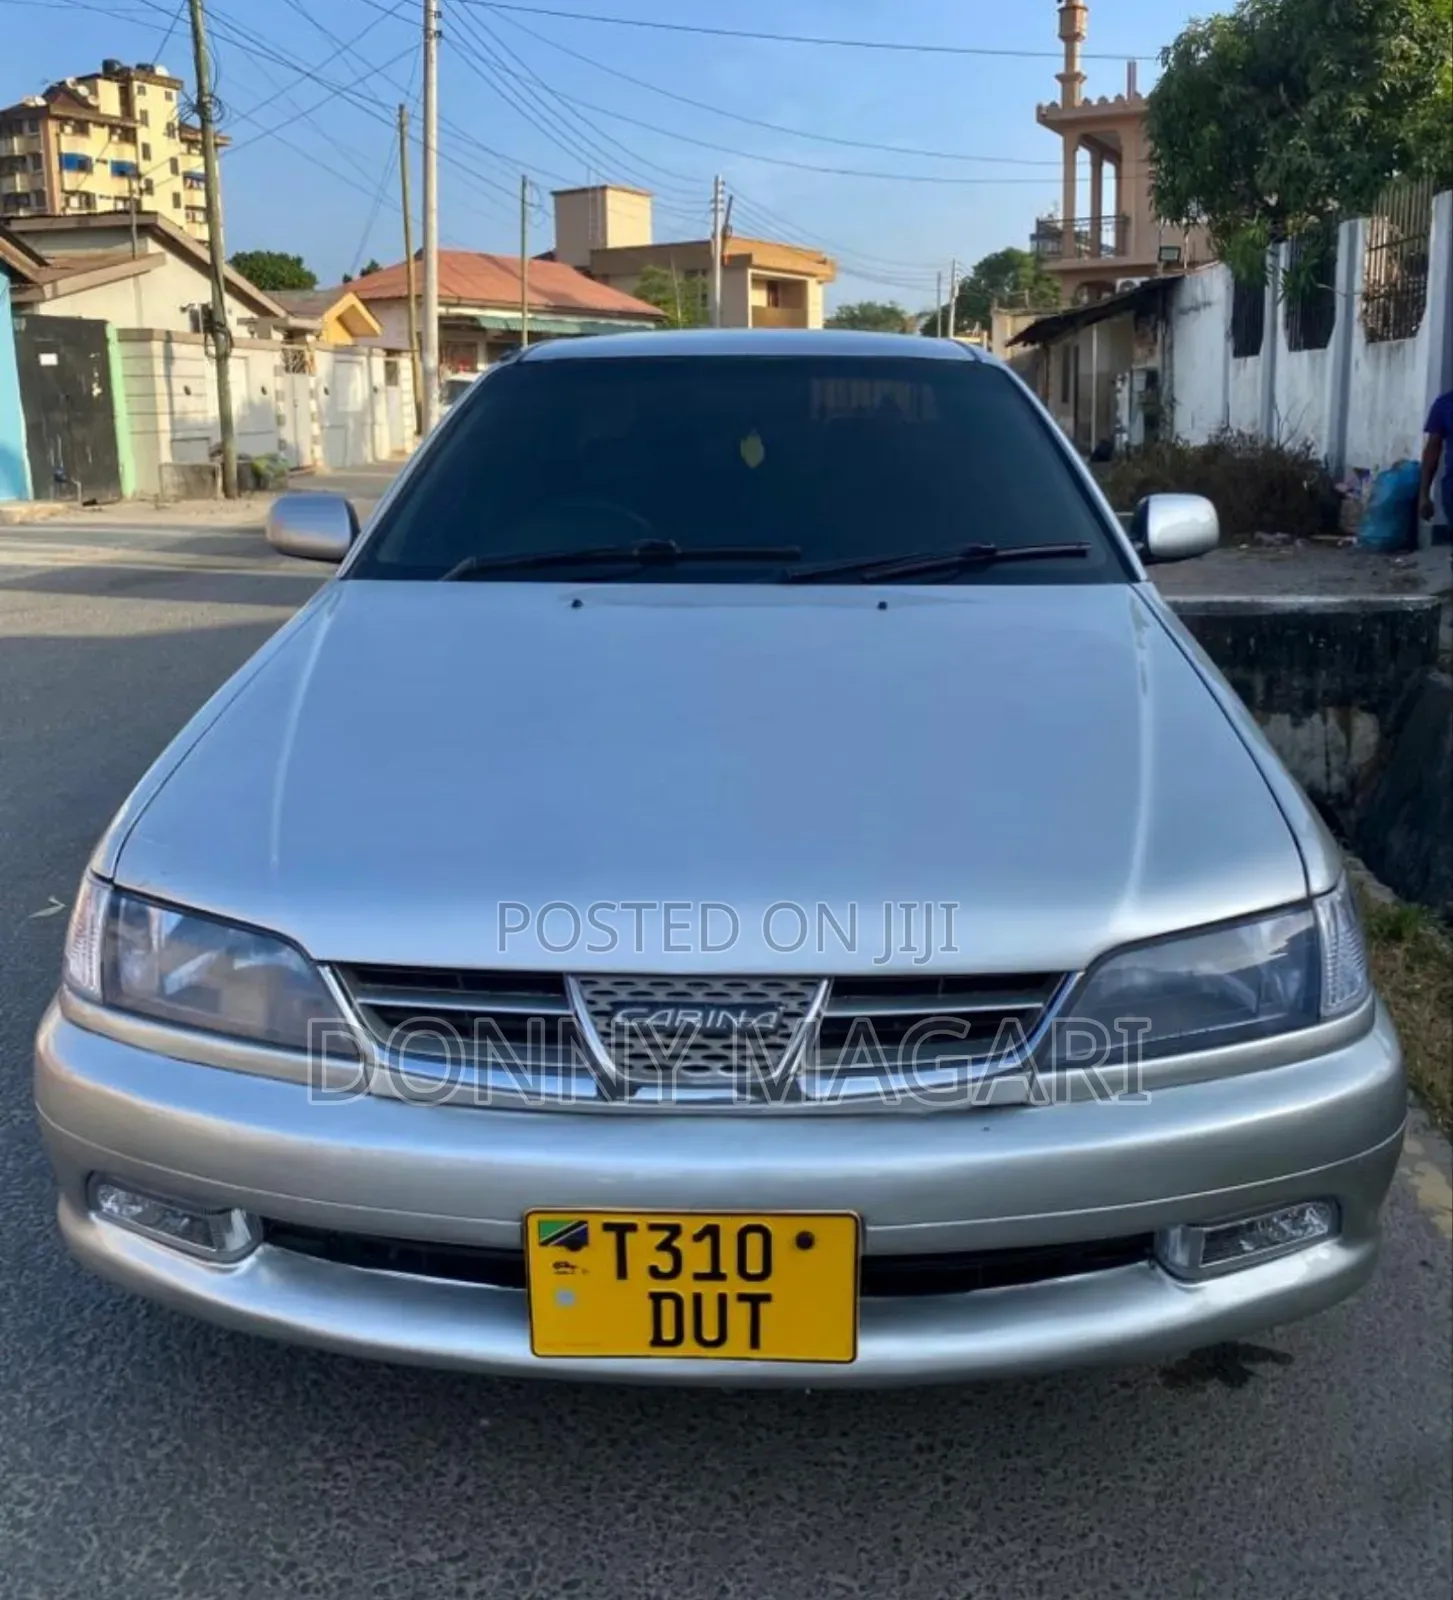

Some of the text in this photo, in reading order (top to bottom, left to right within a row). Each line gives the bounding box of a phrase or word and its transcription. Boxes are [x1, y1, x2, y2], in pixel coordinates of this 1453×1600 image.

[613, 1005, 784, 1029] CARINA
[602, 1221, 773, 1282] T310
[648, 1291, 773, 1350] DUT
